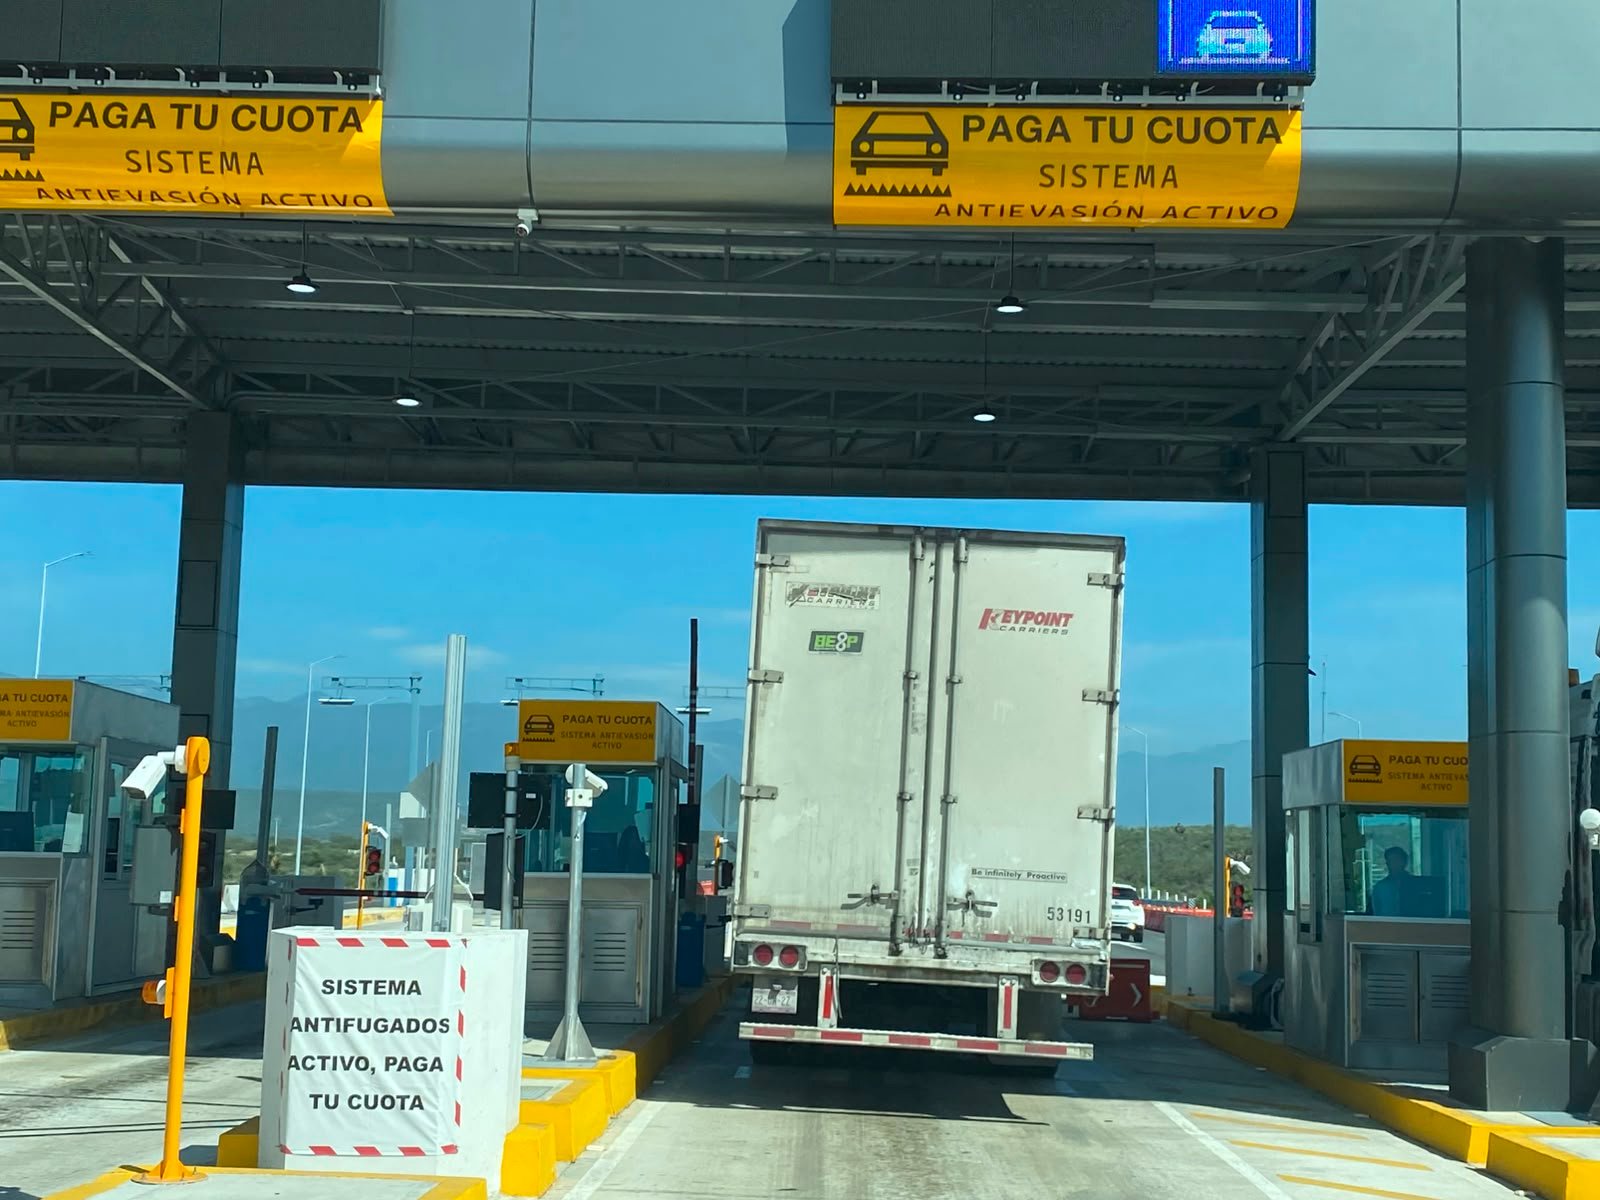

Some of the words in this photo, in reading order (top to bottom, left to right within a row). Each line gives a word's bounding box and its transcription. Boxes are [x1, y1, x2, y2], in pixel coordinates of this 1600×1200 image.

[49, 101, 156, 129] PAGA
[170, 103, 218, 131] TU
[231, 104, 363, 133] CUOTA
[962, 114, 1071, 144] PAGA
[1084, 115, 1134, 144] TU
[1146, 116, 1283, 145] CUOTA
[125, 150, 264, 176] SISTEMA
[1039, 163, 1178, 189] SISTEMA
[36, 186, 241, 207] ANTIEVASIÓN
[260, 192, 374, 208] ACTIVO
[934, 200, 1144, 219] ANTIEVASIÓN
[1161, 205, 1279, 220] ACTIVO
[978, 608, 1074, 630] KEYPOINT
[999, 626, 1069, 636] CARRIERS
[13, 694, 26, 702] TU
[30, 694, 68, 703] CUOTA
[7, 720, 37, 728] ACTIVO
[562, 715, 593, 724] PAGA
[597, 715, 610, 725] TU
[614, 716, 652, 725] CUOTA
[560, 731, 596, 739] SISTEMA
[592, 742, 621, 750] ACTIVO
[1389, 755, 1421, 765] PAGA
[1424, 756, 1440, 766] TU
[1388, 772, 1425, 780] SISTEMA
[1421, 784, 1452, 792] ACTIVO
[971, 868, 983, 876] Be
[985, 870, 1022, 880] infinitely
[1026, 872, 1066, 881] Proactive
[1047, 907, 1091, 924] 53191
[321, 979, 422, 996] SISTEMA
[290, 1017, 450, 1034] ANTIFUGADOS
[288, 1055, 376, 1075] ACTIVO,
[384, 1056, 444, 1072] PAGA
[309, 1094, 339, 1110] TU
[347, 1094, 425, 1110] CUOTA
